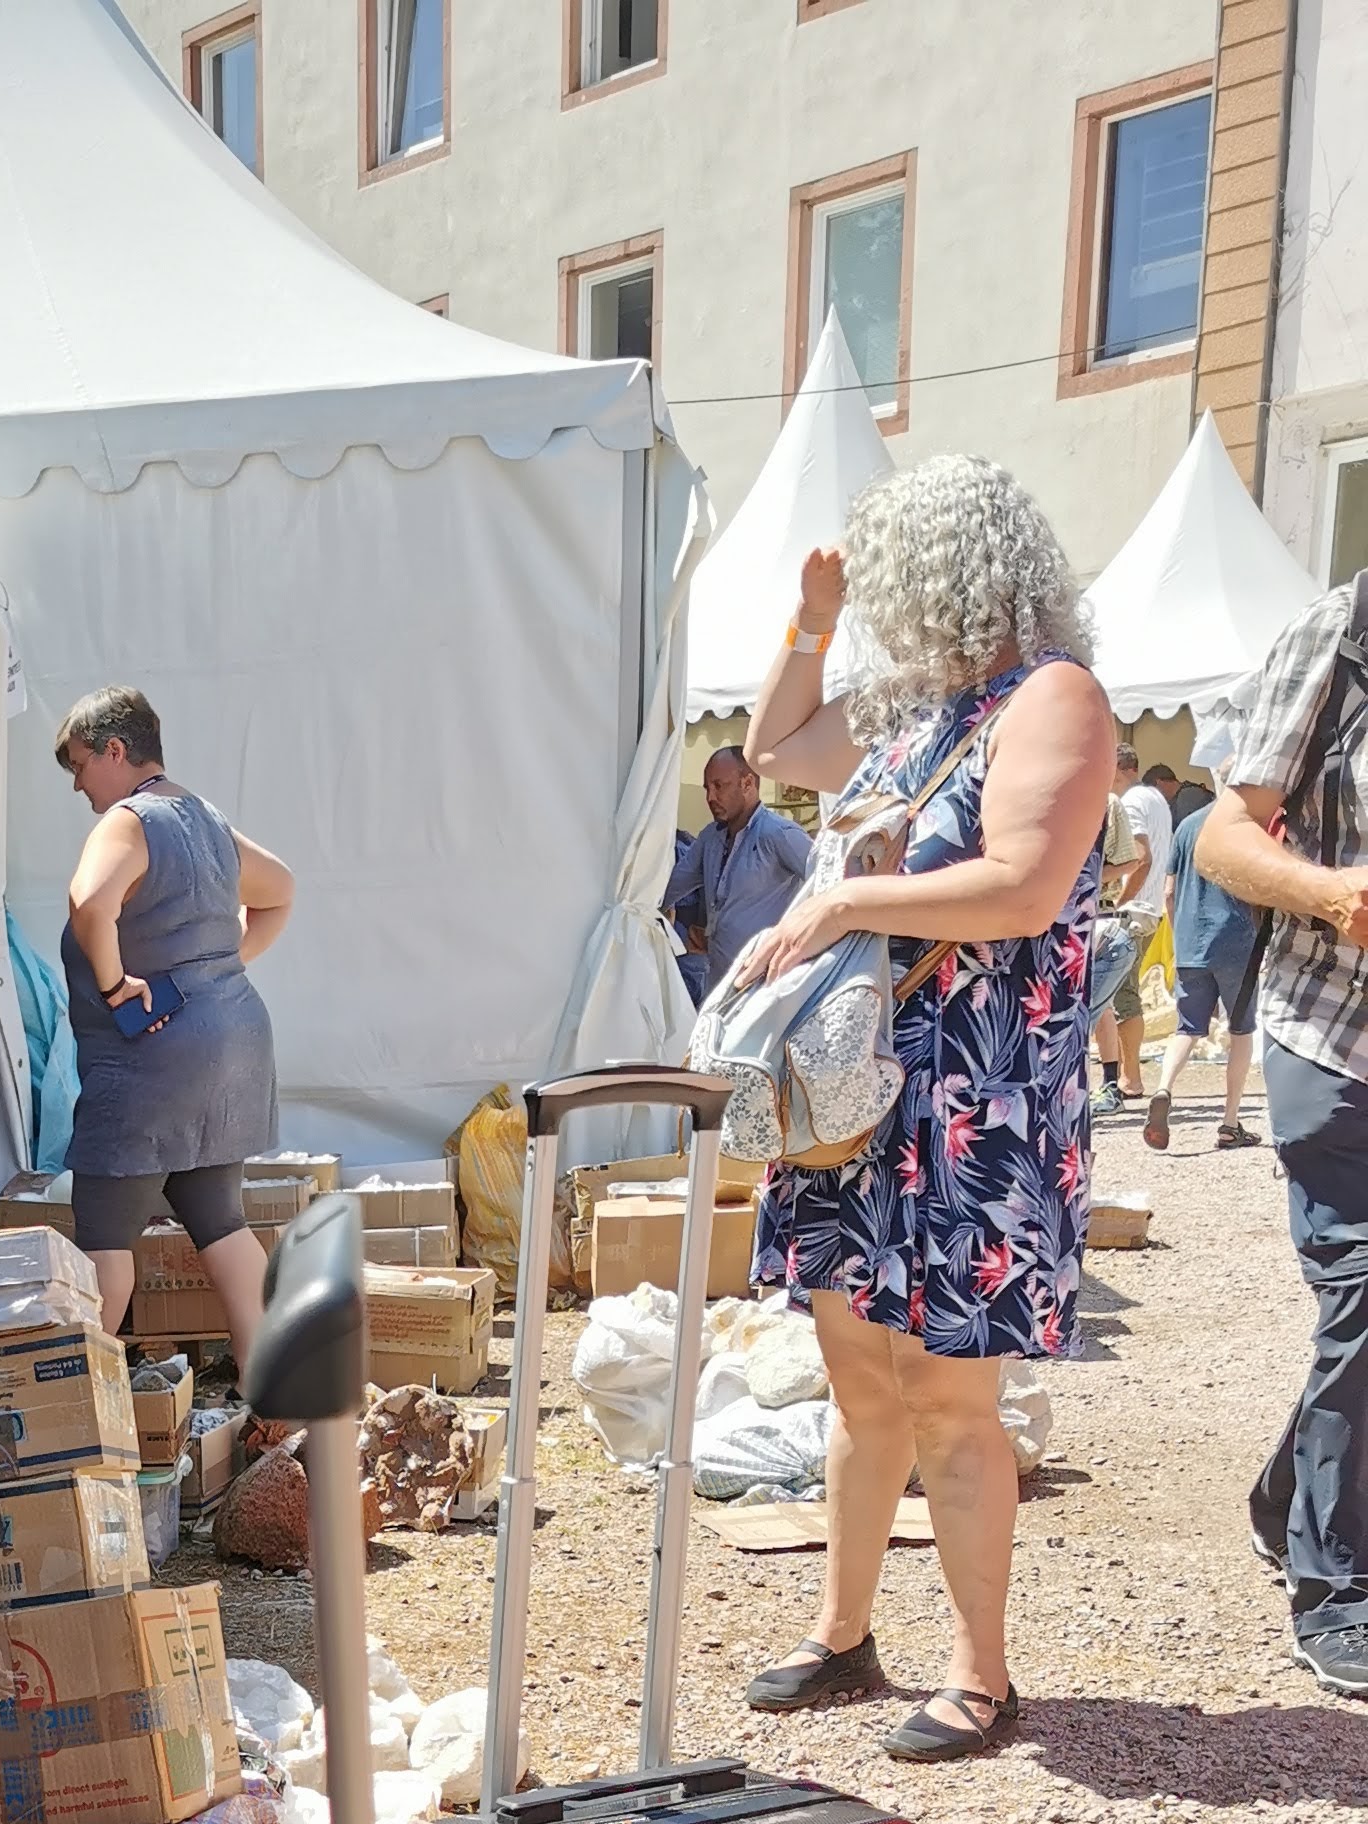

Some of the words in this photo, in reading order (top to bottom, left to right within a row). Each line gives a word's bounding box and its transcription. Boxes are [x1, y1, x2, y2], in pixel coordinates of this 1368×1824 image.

[62, 1782, 91, 1796] direct
[91, 1777, 129, 1791] sunlight
[59, 1800, 95, 1815] harmful
[96, 1793, 150, 1810] substances
